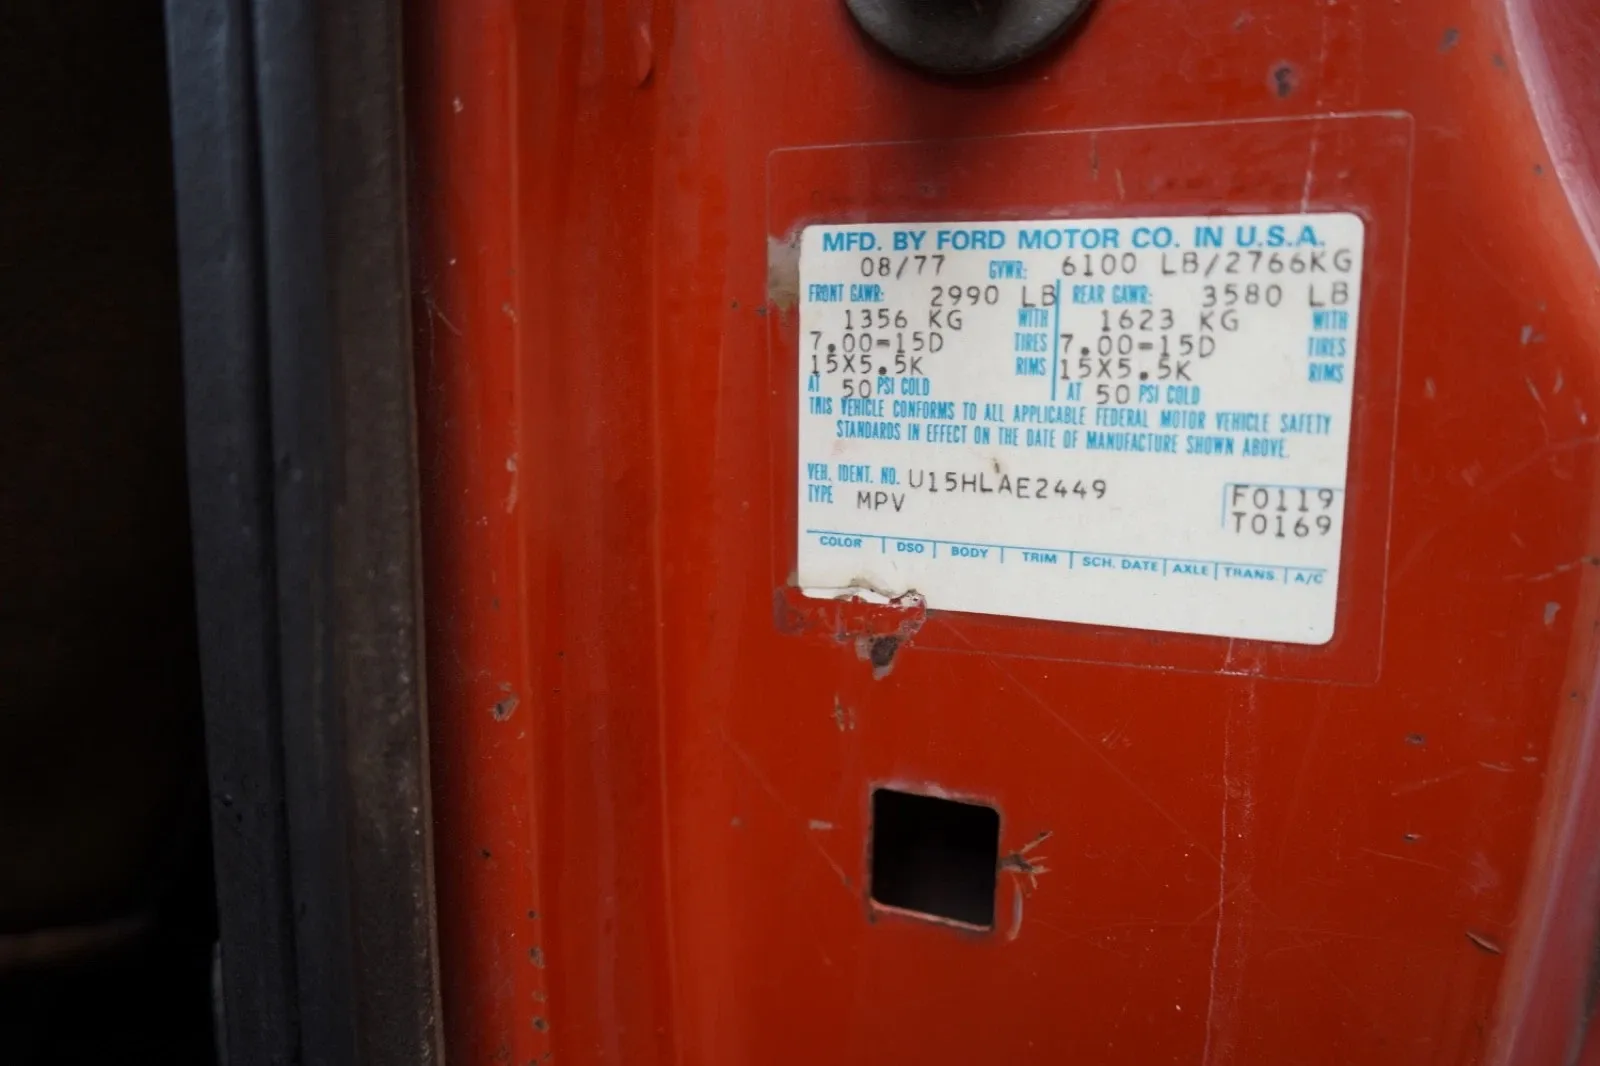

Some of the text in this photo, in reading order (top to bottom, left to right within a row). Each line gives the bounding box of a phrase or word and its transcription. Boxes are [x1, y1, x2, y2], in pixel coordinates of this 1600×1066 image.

[823, 225, 1326, 251] MFD. BY FORD MOTOR CO. IN U.S.A.
[861, 255, 946, 279] 08/77
[989, 260, 1028, 279] GVWR:
[1062, 249, 1352, 277] 6100 LB/2766KG
[808, 284, 884, 302] FRONT GAWR:
[931, 285, 1057, 307] 2990 LB
[1072, 284, 1152, 304] REAR GAWR:
[1203, 282, 1348, 307] 3580 LB
[845, 309, 962, 330] 1356 KG
[1018, 308, 1048, 328] WITH
[1101, 308, 1238, 332] 1623 KG
[1312, 310, 1348, 330] WITH
[1014, 332, 1047, 352] TIRES
[1308, 337, 1346, 357] TIRES
[811, 353, 924, 376] 15X5.5K
[1016, 357, 1046, 376] RIMS
[1060, 359, 1192, 380] 15X5.5K
[1308, 363, 1344, 383] RIMS
[808, 375, 930, 399] AT 50 PSI COLD
[1067, 383, 1200, 405] AT 50 PSI COLD
[810, 396, 1331, 434] THIS VEHICLE CONFORMS TO ALL APPLICABLE FEDERAL MOTOR VEHICLE SAFETY
[837, 420, 1289, 458] STANDARDS IN EFFECT ON THE DATE OF MANUFACTURE SHOWN ABOVE.
[808, 463, 1106, 500] VEH. IDENT. NO. U15HLAE2449
[809, 485, 905, 512] TYPE MPV
[1232, 484, 1334, 512] F0119
[1232, 512, 1331, 538] T0169
[820, 535, 862, 548] COLOR
[897, 542, 924, 553] DSO
[951, 547, 988, 559] BODY
[1023, 551, 1057, 564] TRIM
[1082, 556, 1158, 572] SCH. DATE
[1172, 564, 1208, 576] AXLE
[1294, 572, 1323, 584] A/C
